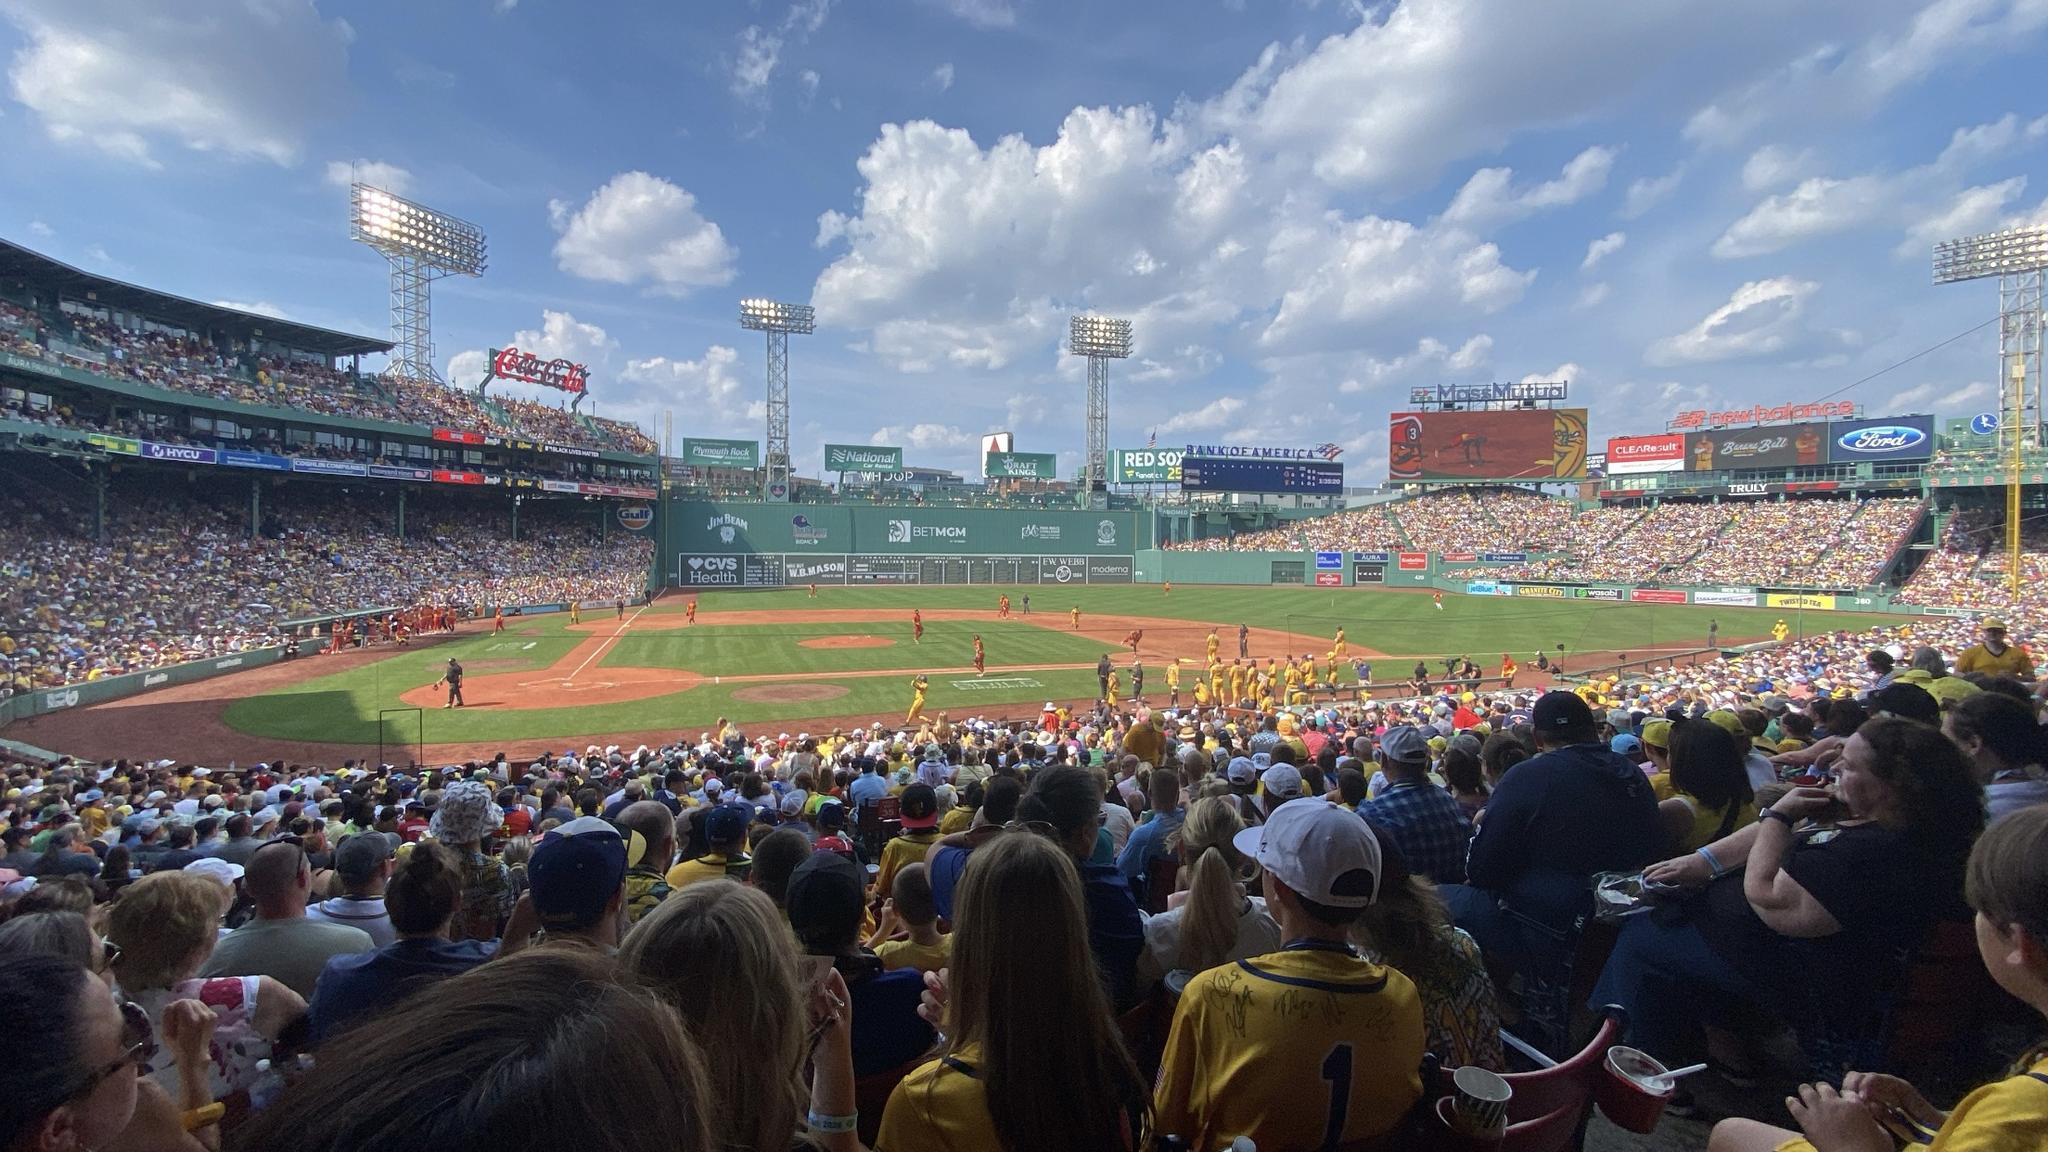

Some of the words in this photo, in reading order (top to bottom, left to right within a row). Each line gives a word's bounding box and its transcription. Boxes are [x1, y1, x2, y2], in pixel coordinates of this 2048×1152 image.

[1436, 380, 1568, 400] MassMutual
[1709, 410, 1751, 425] new
[1755, 400, 1855, 421] balance
[1409, 427, 1417, 440] 3
[1855, 429, 1908, 449] Ford
[166, 448, 200, 459] HYCU
[692, 446, 730, 456] Plymouth
[730, 447, 751, 456] Rock
[846, 450, 896, 463] National
[1186, 444, 1225, 457] BANK
[1231, 446, 1247, 457] OF
[1252, 447, 1315, 460] AMERICA
[1003, 461, 1038, 470] DRAFT
[1124, 452, 1155, 467] RED
[1008, 468, 1037, 476] KINGS
[1728, 483, 1768, 493] TRULY
[618, 507, 650, 520] Gulf
[707, 517, 724, 531] JIM
[724, 513, 749, 531] BEAM
[912, 526, 967, 537] BETMGM
[704, 557, 738, 570] CVS
[1059, 557, 1085, 566] WEBB
[1091, 565, 1129, 574] moderna
[689, 570, 738, 584] Health
[1469, 584, 1493, 594] jetBlue
[1588, 589, 1617, 597] wasabi
[1321, 1041, 1353, 1151] 1
